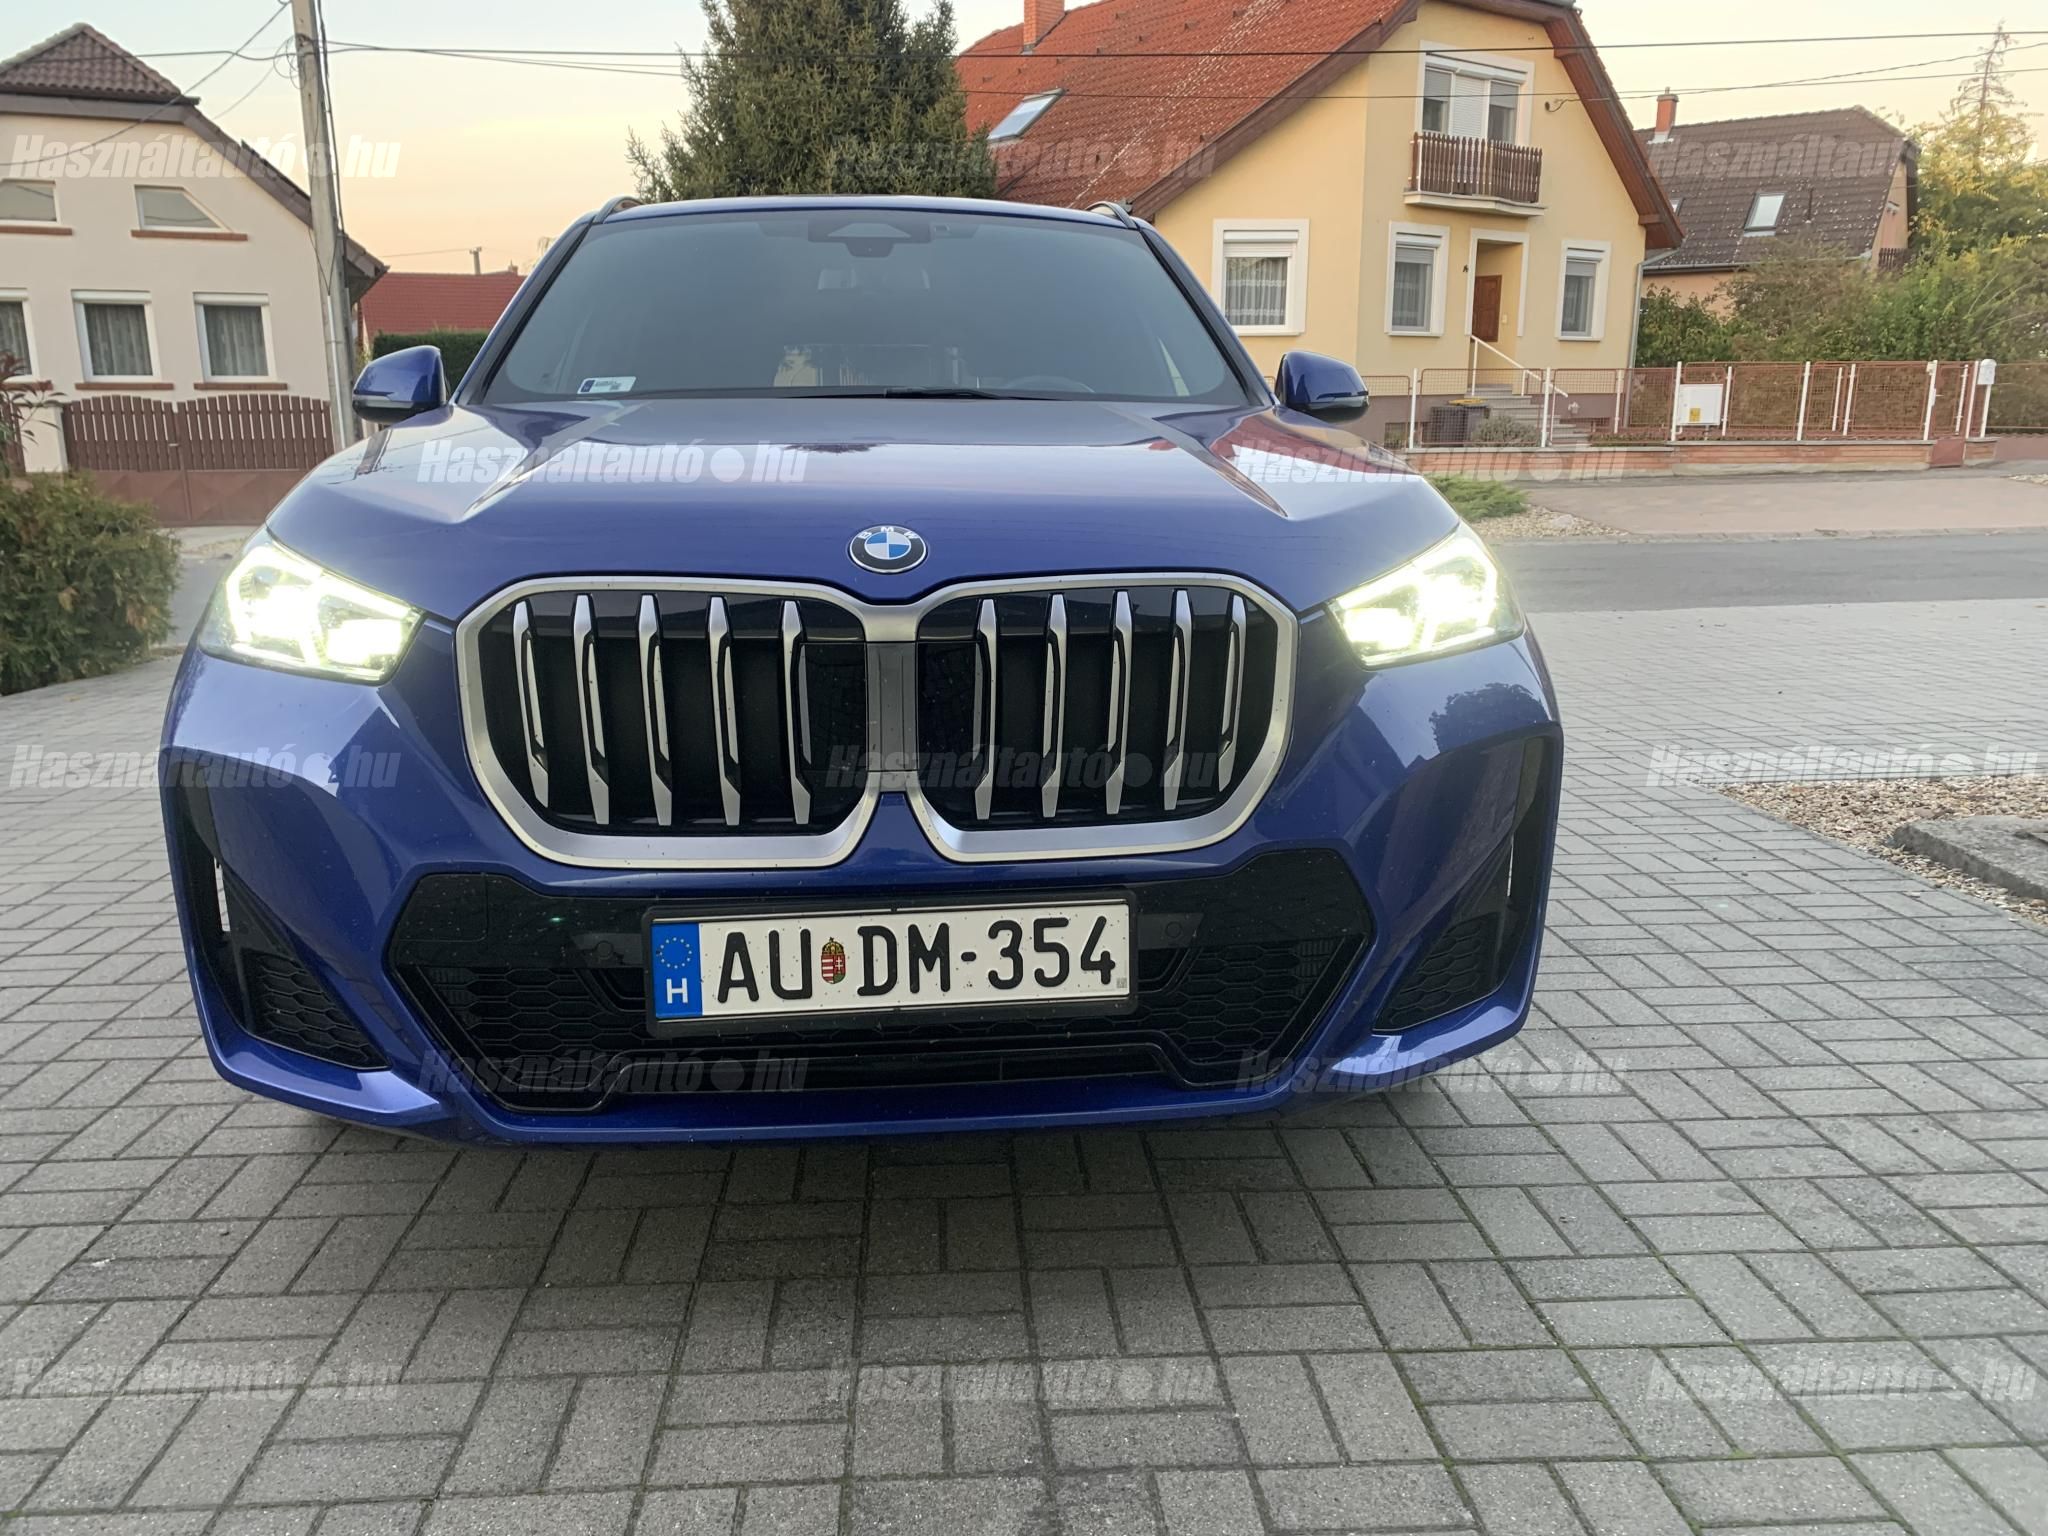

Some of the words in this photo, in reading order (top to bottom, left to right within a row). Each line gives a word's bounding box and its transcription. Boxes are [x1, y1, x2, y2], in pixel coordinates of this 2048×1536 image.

[857, 526, 921, 540] BMW
[717, 928, 812, 1003] AU
[857, 915, 1117, 997] DM-354
[666, 978, 689, 1005] H
